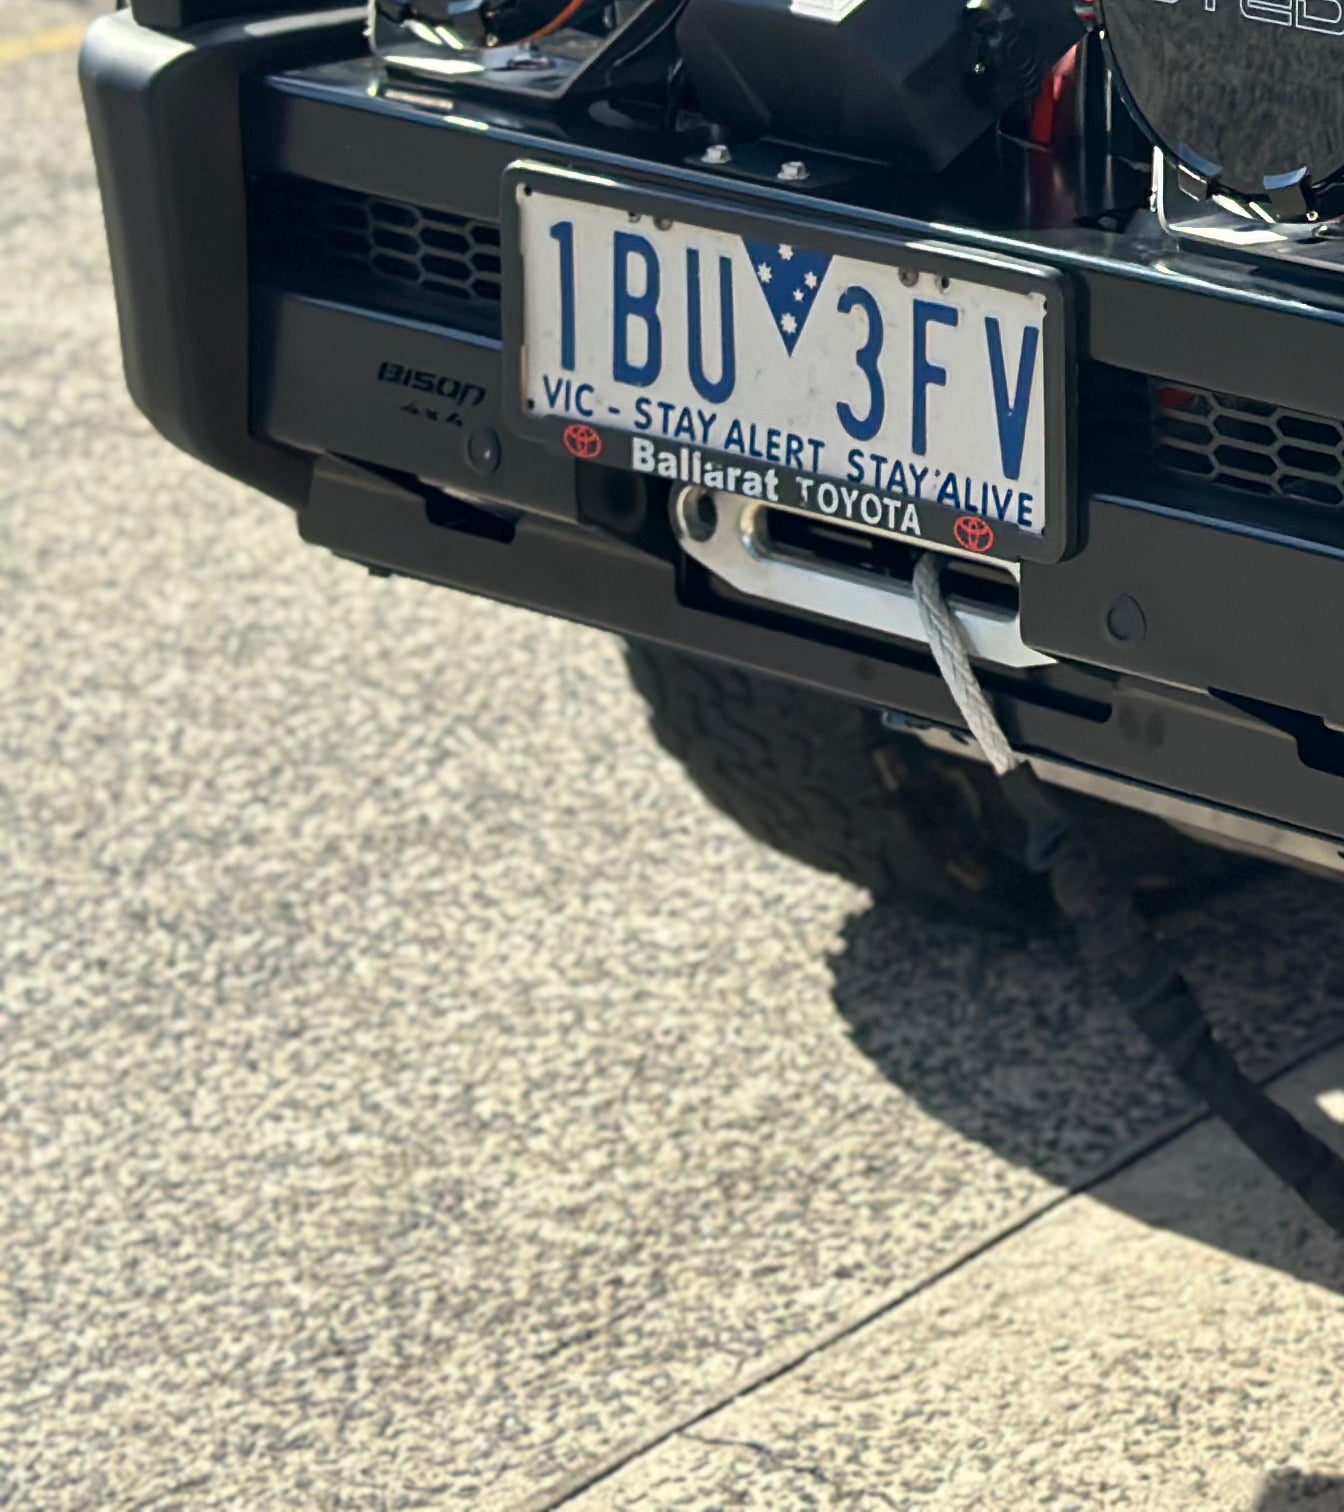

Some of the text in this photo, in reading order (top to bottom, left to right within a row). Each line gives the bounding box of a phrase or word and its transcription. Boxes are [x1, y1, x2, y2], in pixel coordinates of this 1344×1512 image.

[543, 375, 595, 418] VIC
[634, 396, 718, 442] STAY
[723, 419, 826, 474] ALERT
[847, 448, 924, 497] STAY
[936, 472, 1034, 528] ALIVE
[631, 435, 921, 537] Ballarat TOYOTA
